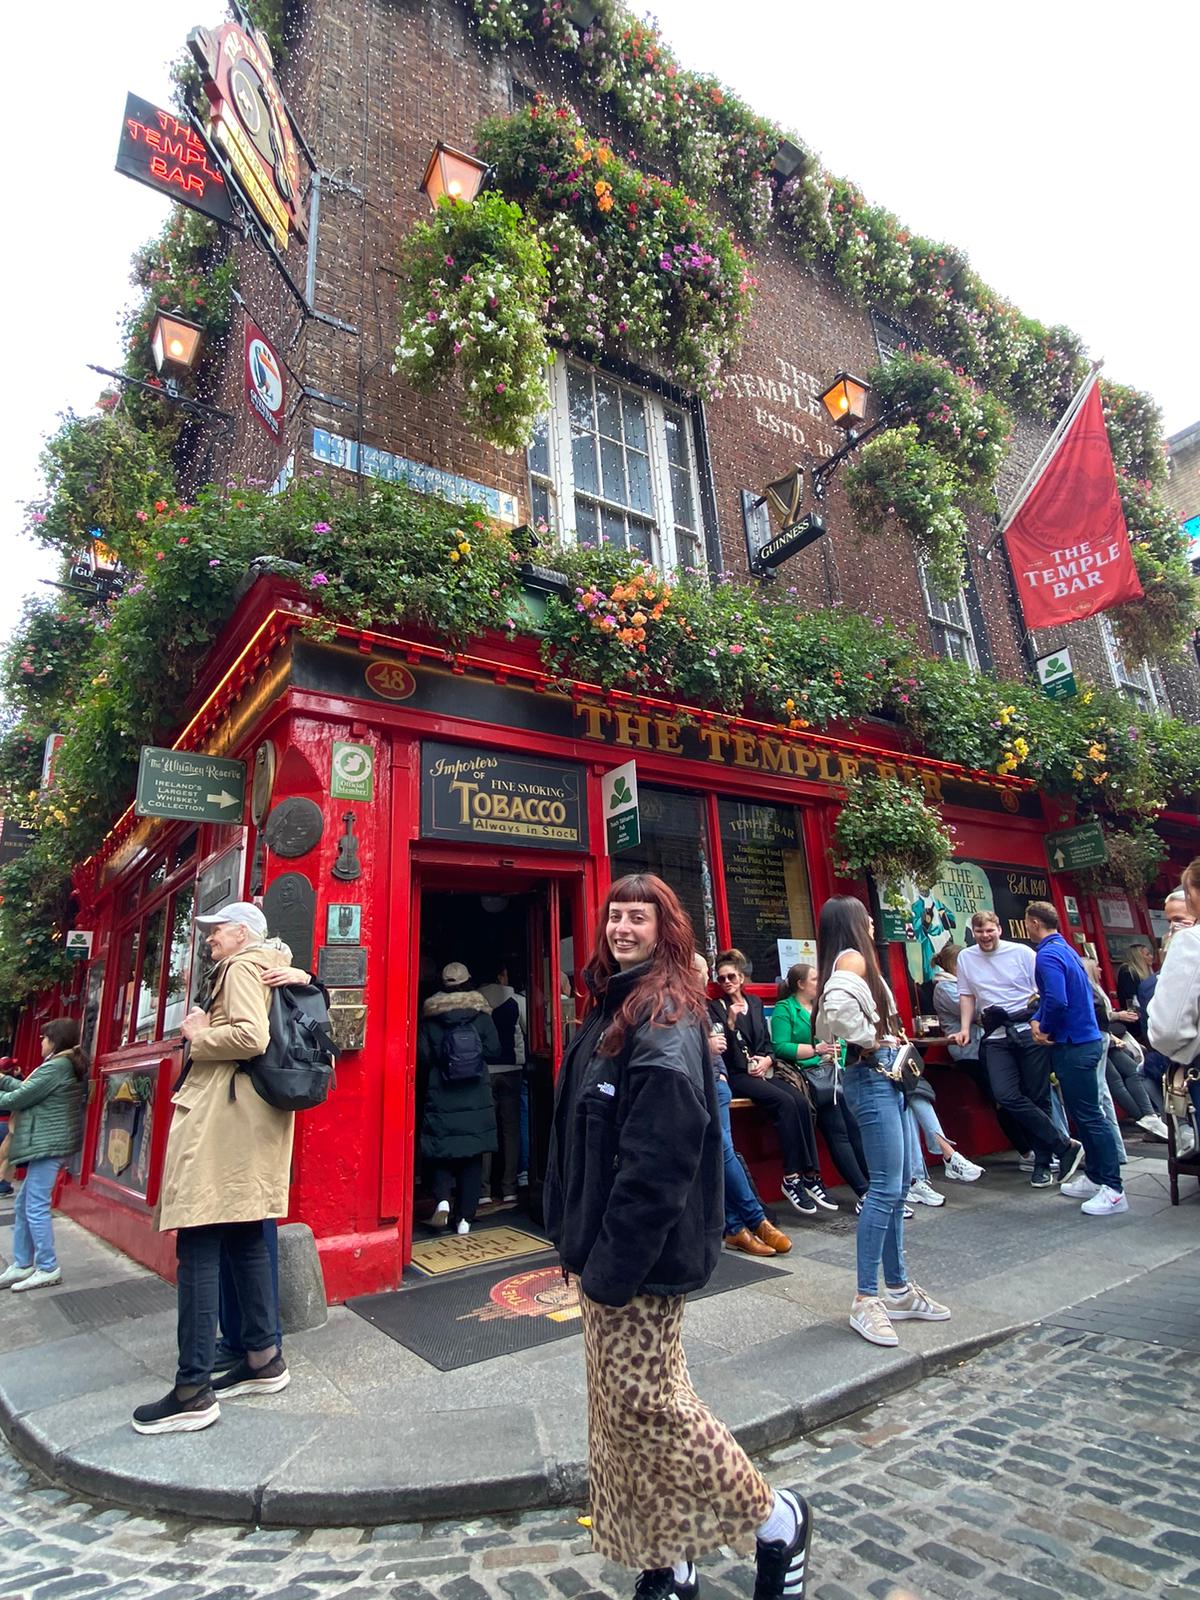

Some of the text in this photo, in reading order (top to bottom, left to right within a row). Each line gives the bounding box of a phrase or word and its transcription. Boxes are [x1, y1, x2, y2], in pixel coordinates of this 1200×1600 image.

[157, 111, 206, 152] THE
[151, 156, 205, 197] BAR
[775, 356, 822, 396] THE
[725, 373, 823, 421] TEMPLE
[760, 518, 811, 560] GUINNESS
[1050, 542, 1092, 564] THE
[1023, 542, 1121, 588] TEMPLE
[75, 566, 124, 586] GUSS
[1052, 570, 1104, 599] BAR
[374, 667, 405, 691] 48
[575, 702, 684, 754] THE
[701, 728, 860, 784] TEMPLE
[149, 757, 241, 781] The Whiskey Reserve
[430, 756, 498, 780] Importers
[473, 771, 486, 780] OF
[154, 779, 202, 791] IRELAND'S
[158, 787, 199, 797] LARGEST
[338, 785, 368, 796] Member
[340, 780, 365, 789] Official
[491, 779, 565, 799] FINE SMOKING
[147, 800, 205, 812] COLLECTION
[156, 794, 199, 804] WHISKEY
[448, 780, 567, 826] TOBACCO
[474, 820, 577, 840] Always in Stock
[773, 823, 795, 840] BAR
[947, 867, 973, 884] THE
[940, 881, 986, 900] TEMPLE
[1030, 878, 1047, 897] 1840
[955, 898, 978, 914] BAR
[421, 1235, 529, 1261] TEMPLE
[458, 1245, 518, 1262] BAR
